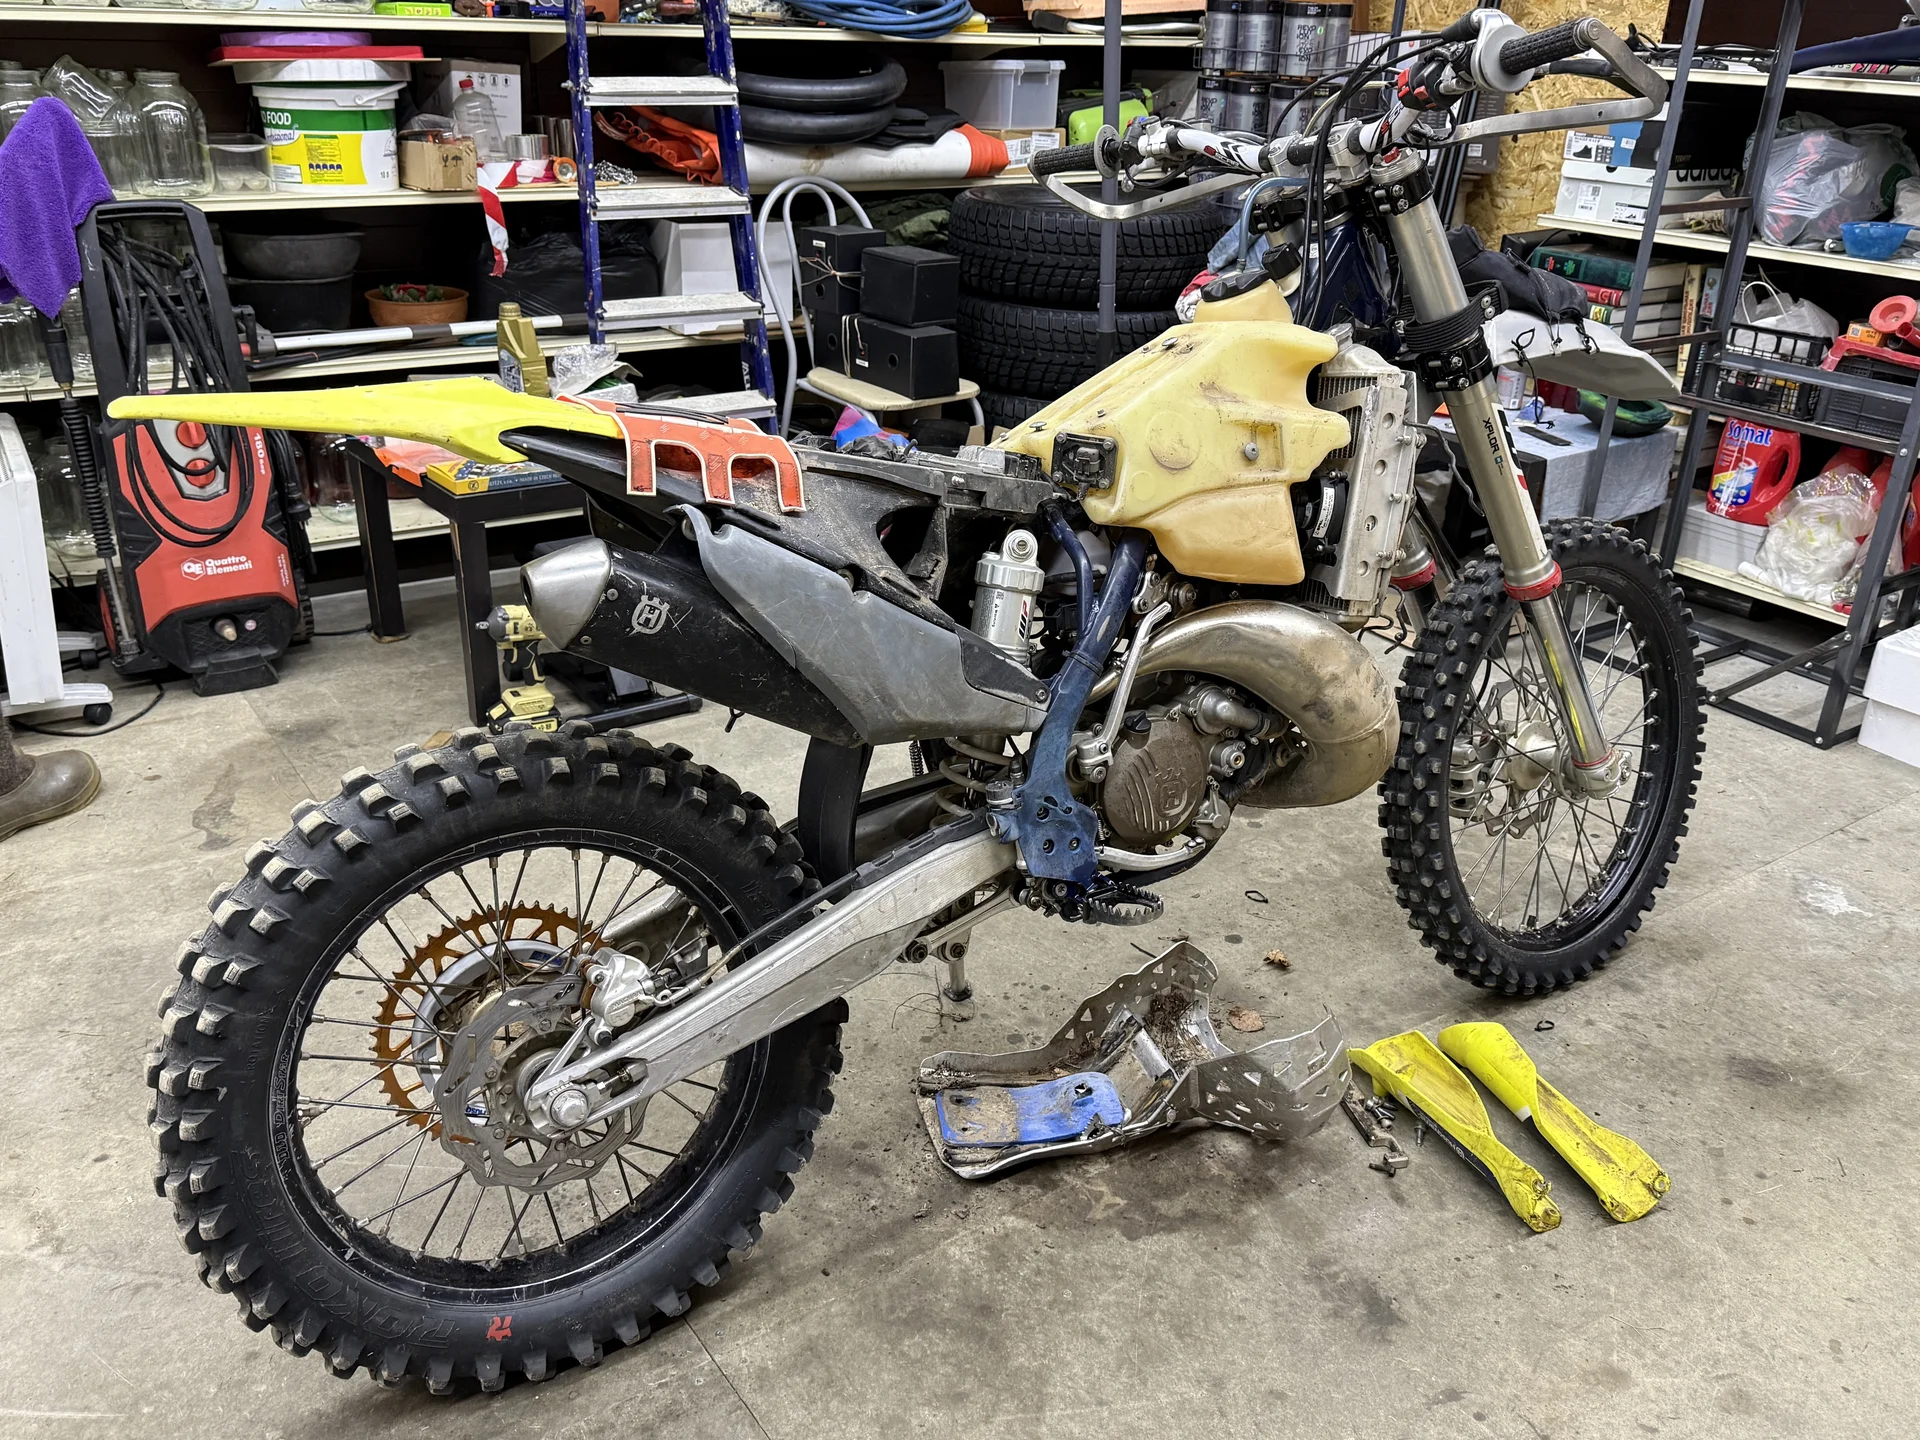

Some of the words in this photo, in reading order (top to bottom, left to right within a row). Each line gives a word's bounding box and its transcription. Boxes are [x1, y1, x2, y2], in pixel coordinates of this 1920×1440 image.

[267, 111, 291, 125] FOOD
[253, 433, 265, 458] 180
[1483, 417, 1500, 454] XPLOR
[1726, 420, 1773, 446] Somat
[205, 555, 247, 567] Quattro
[206, 560, 252, 575] Elementi
[246, 1017, 270, 1071] ROTATION
